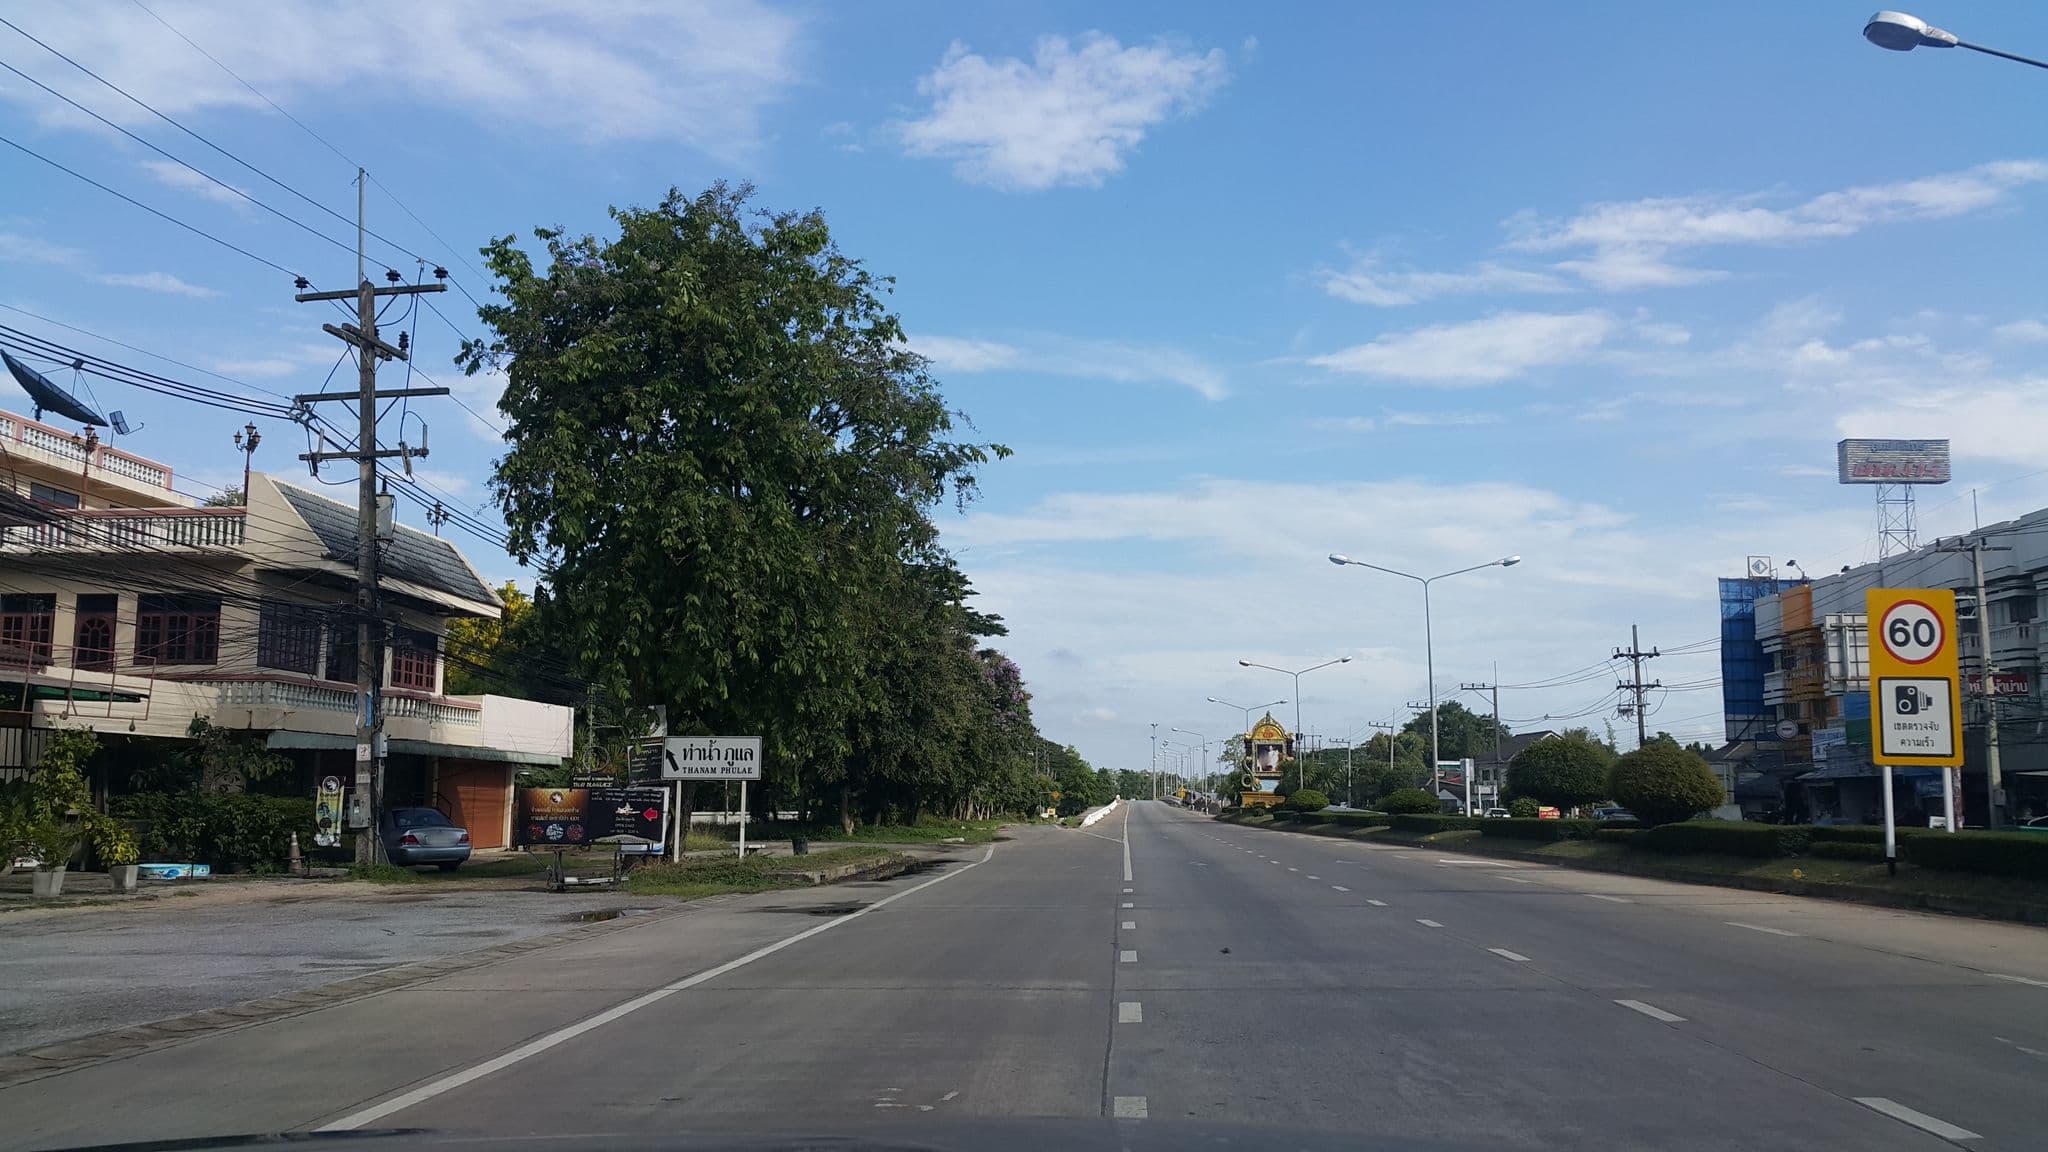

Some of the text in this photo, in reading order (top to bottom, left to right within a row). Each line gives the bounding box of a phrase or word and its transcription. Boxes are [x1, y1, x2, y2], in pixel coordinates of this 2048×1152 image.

[1889, 618, 1936, 648] 60
[1893, 720, 1940, 732] เขตตรวจจับ
[1900, 736, 1935, 748] ความเร็ว
[682, 739, 754, 766] ท่าน้ำ ภูแล
[682, 766, 753, 774] THANAM PHULAE
